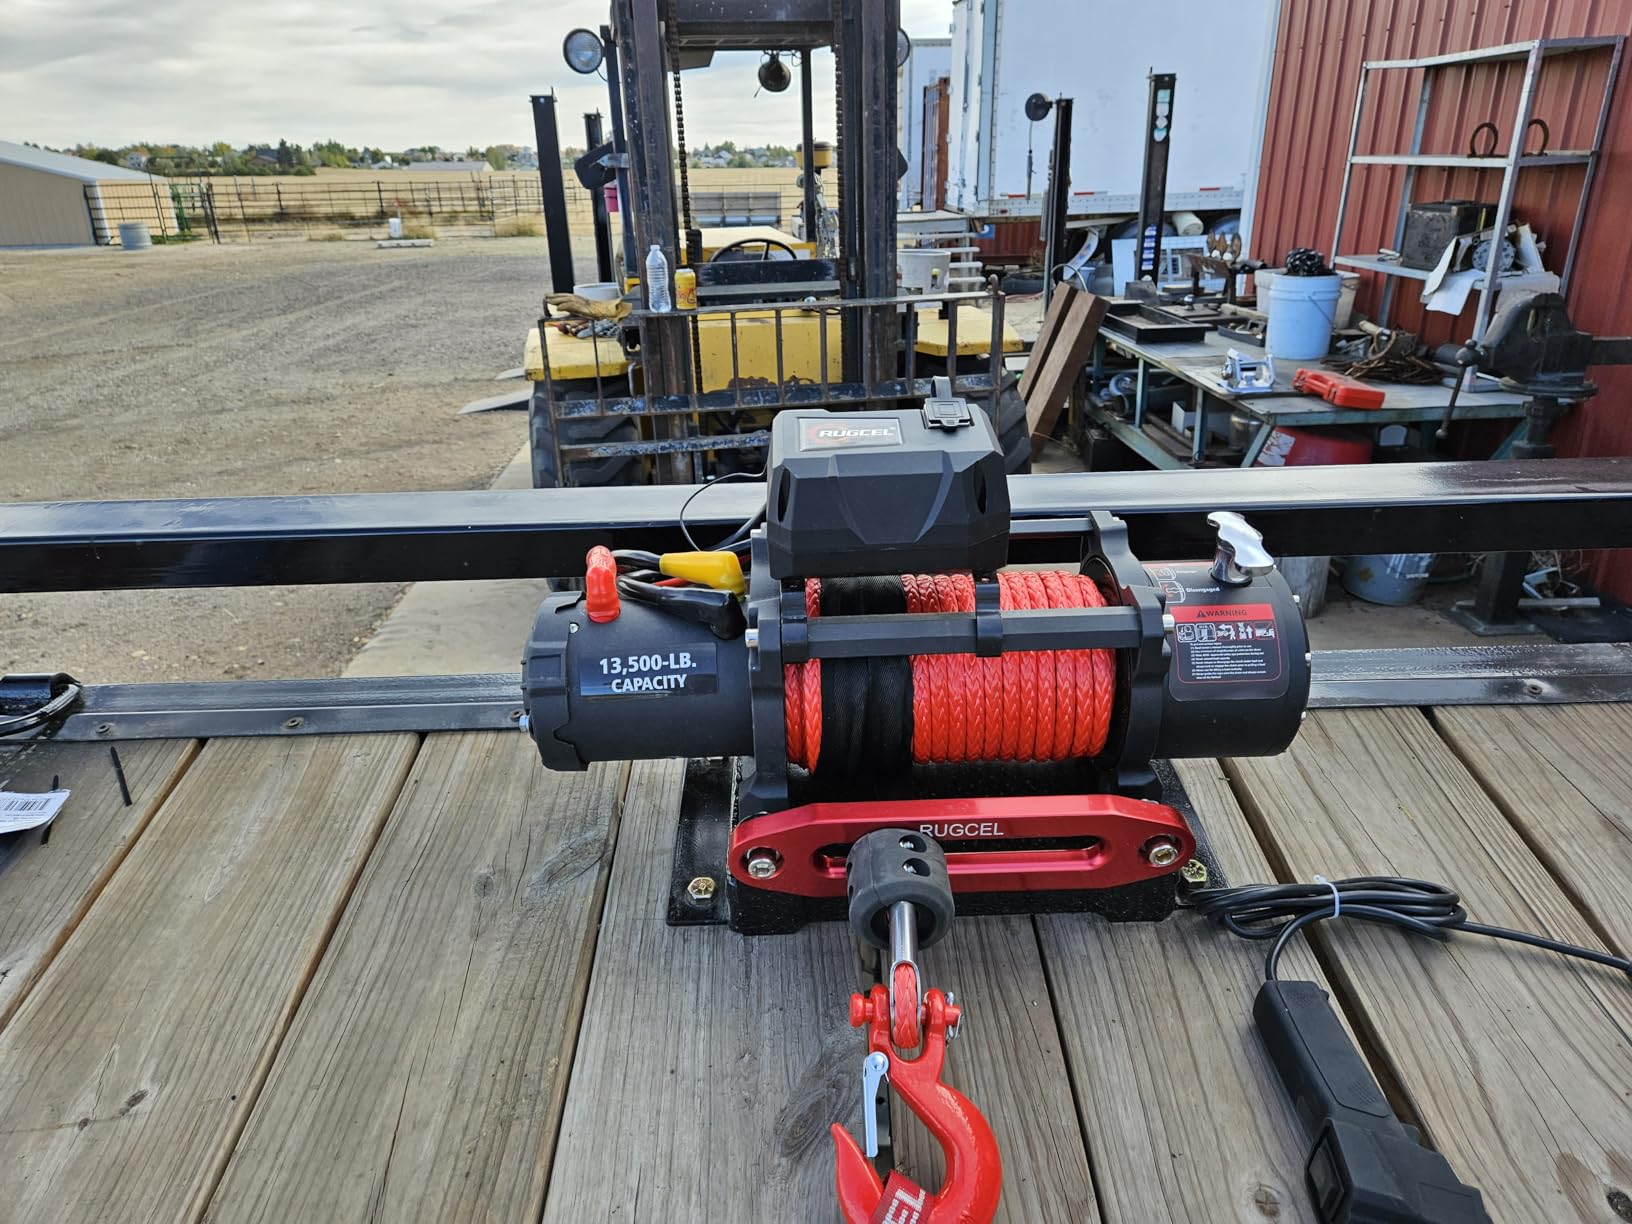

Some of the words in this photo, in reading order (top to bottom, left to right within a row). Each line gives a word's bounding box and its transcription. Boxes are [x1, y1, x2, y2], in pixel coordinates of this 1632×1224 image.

[818, 428, 895, 438] RUGCEL
[1205, 609, 1248, 618] WARNING
[599, 652, 697, 675] 13,500-LB.
[611, 674, 688, 693] CAPACITY
[919, 822, 1005, 838] RUGCEL
